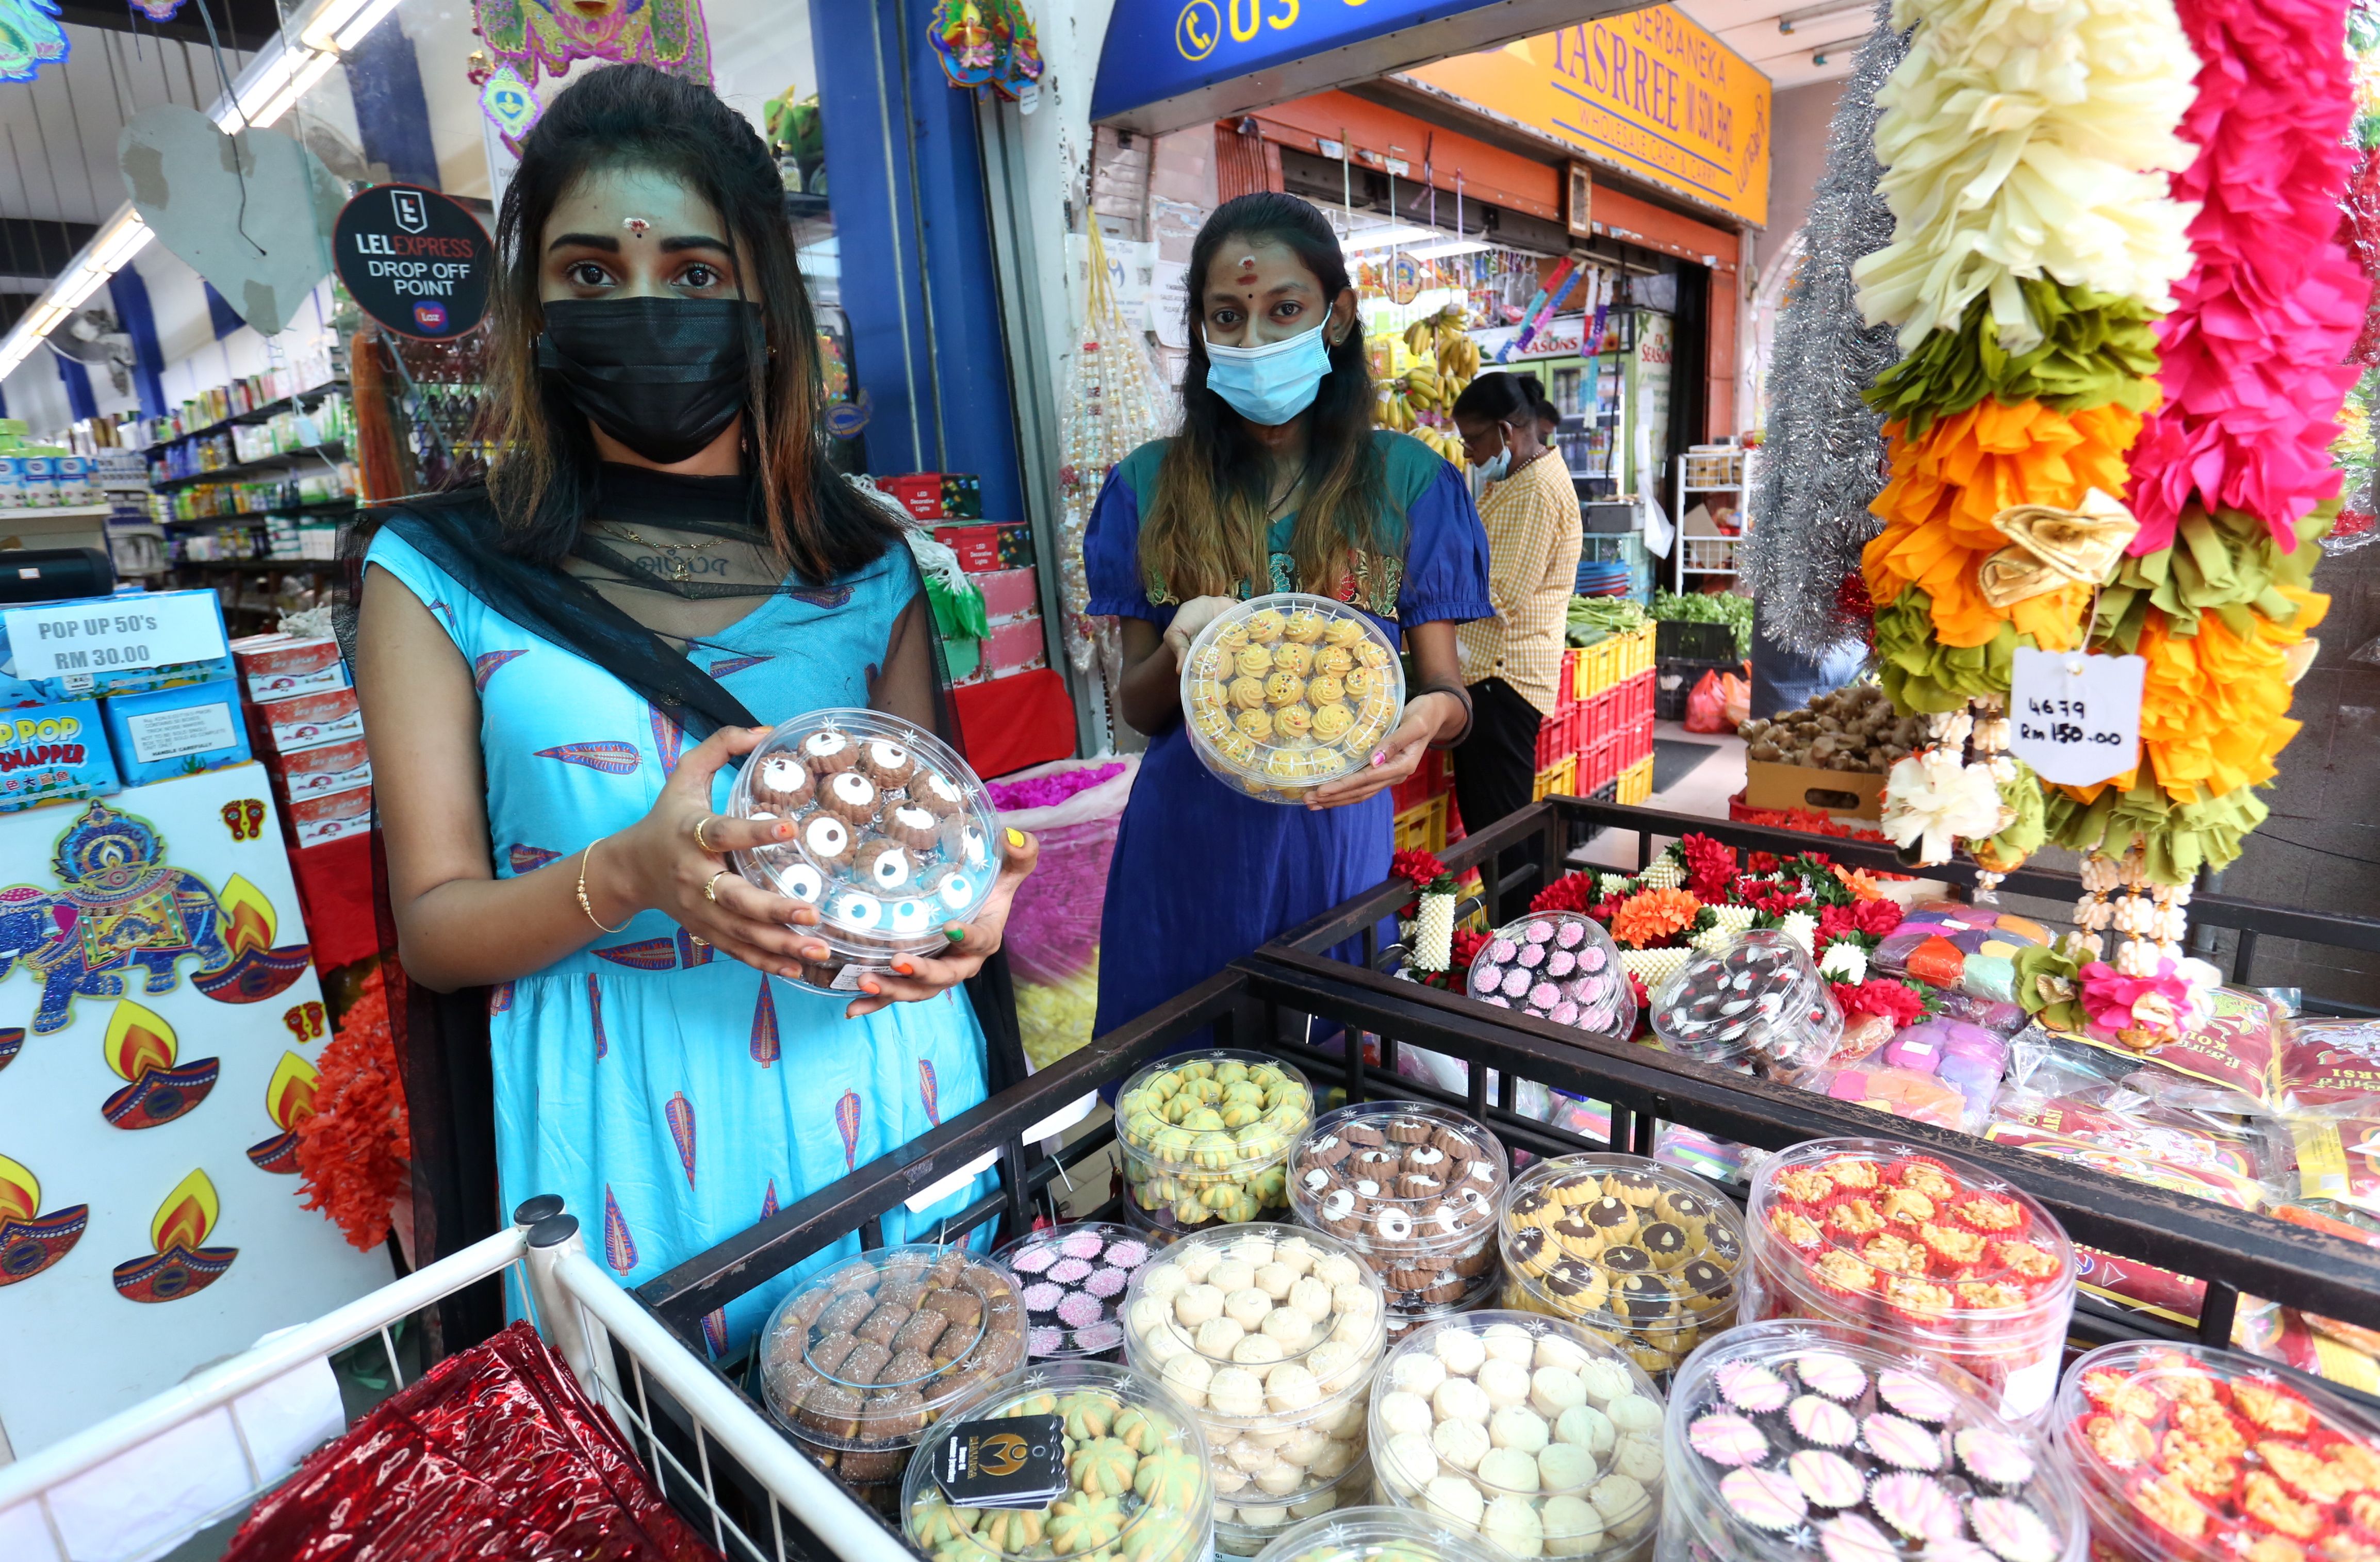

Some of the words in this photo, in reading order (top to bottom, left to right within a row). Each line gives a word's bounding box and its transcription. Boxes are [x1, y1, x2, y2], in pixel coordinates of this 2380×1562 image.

[368, 260, 428, 277] DROP
[432, 263, 470, 279] OFF
[393, 279, 454, 295] POINT
[1523, 337, 1578, 353] ASONS
[1642, 343, 1672, 364] SEASON
[39, 621, 79, 640] POP
[84, 617, 110, 636] UP
[116, 614, 158, 633] 50's
[55, 651, 89, 670] RM
[92, 645, 150, 666] 30.00
[2029, 697, 2084, 719] 4679
[15, 717, 79, 744] POP
[2051, 722, 2121, 746] 150.00
[967, 1436, 979, 1479] MALLIGA
